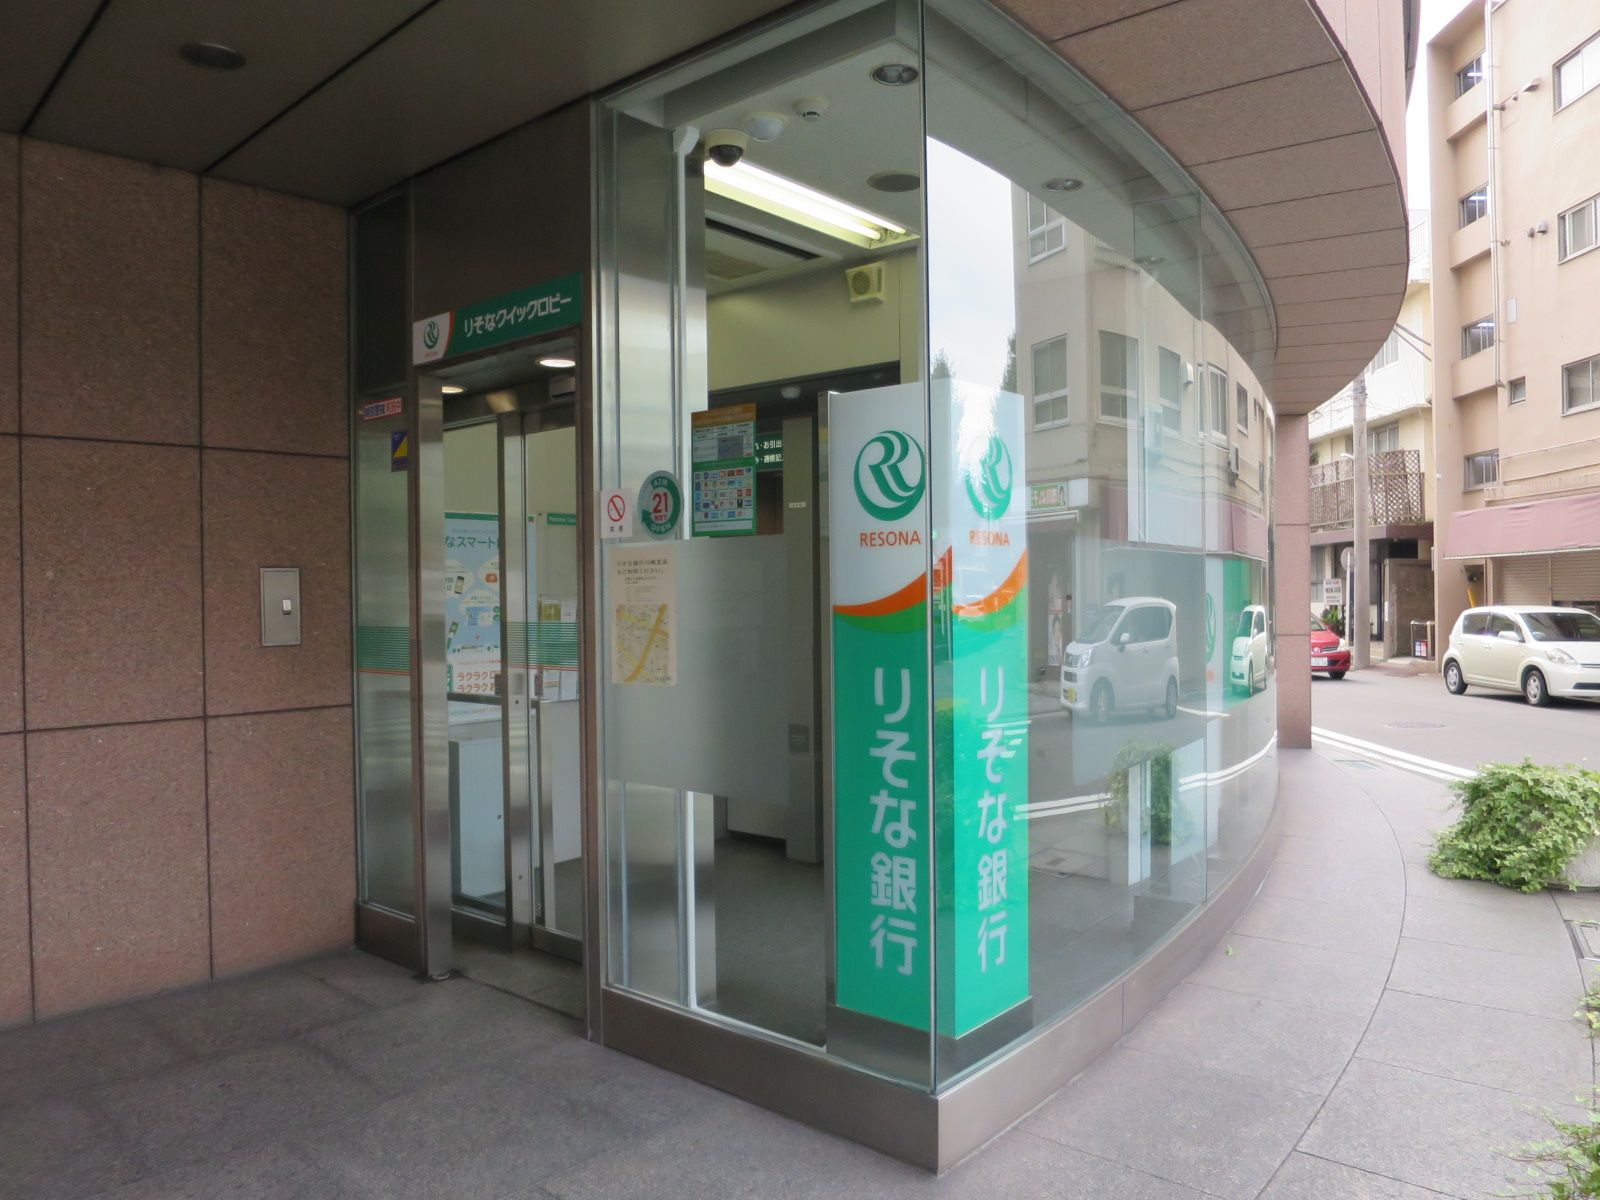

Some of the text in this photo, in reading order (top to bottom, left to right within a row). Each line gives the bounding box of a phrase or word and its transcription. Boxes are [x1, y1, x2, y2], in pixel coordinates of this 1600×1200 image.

[463, 292, 572, 338] りそなクイックロビー
[652, 491, 668, 513] 21
[651, 521, 672, 533] OPEN
[444, 535, 500, 550] なスマート
[859, 530, 921, 548] RESONA
[969, 529, 1010, 546] RESONA
[869, 666, 918, 976] りそな銀行
[976, 665, 1008, 974] りそな銀行
